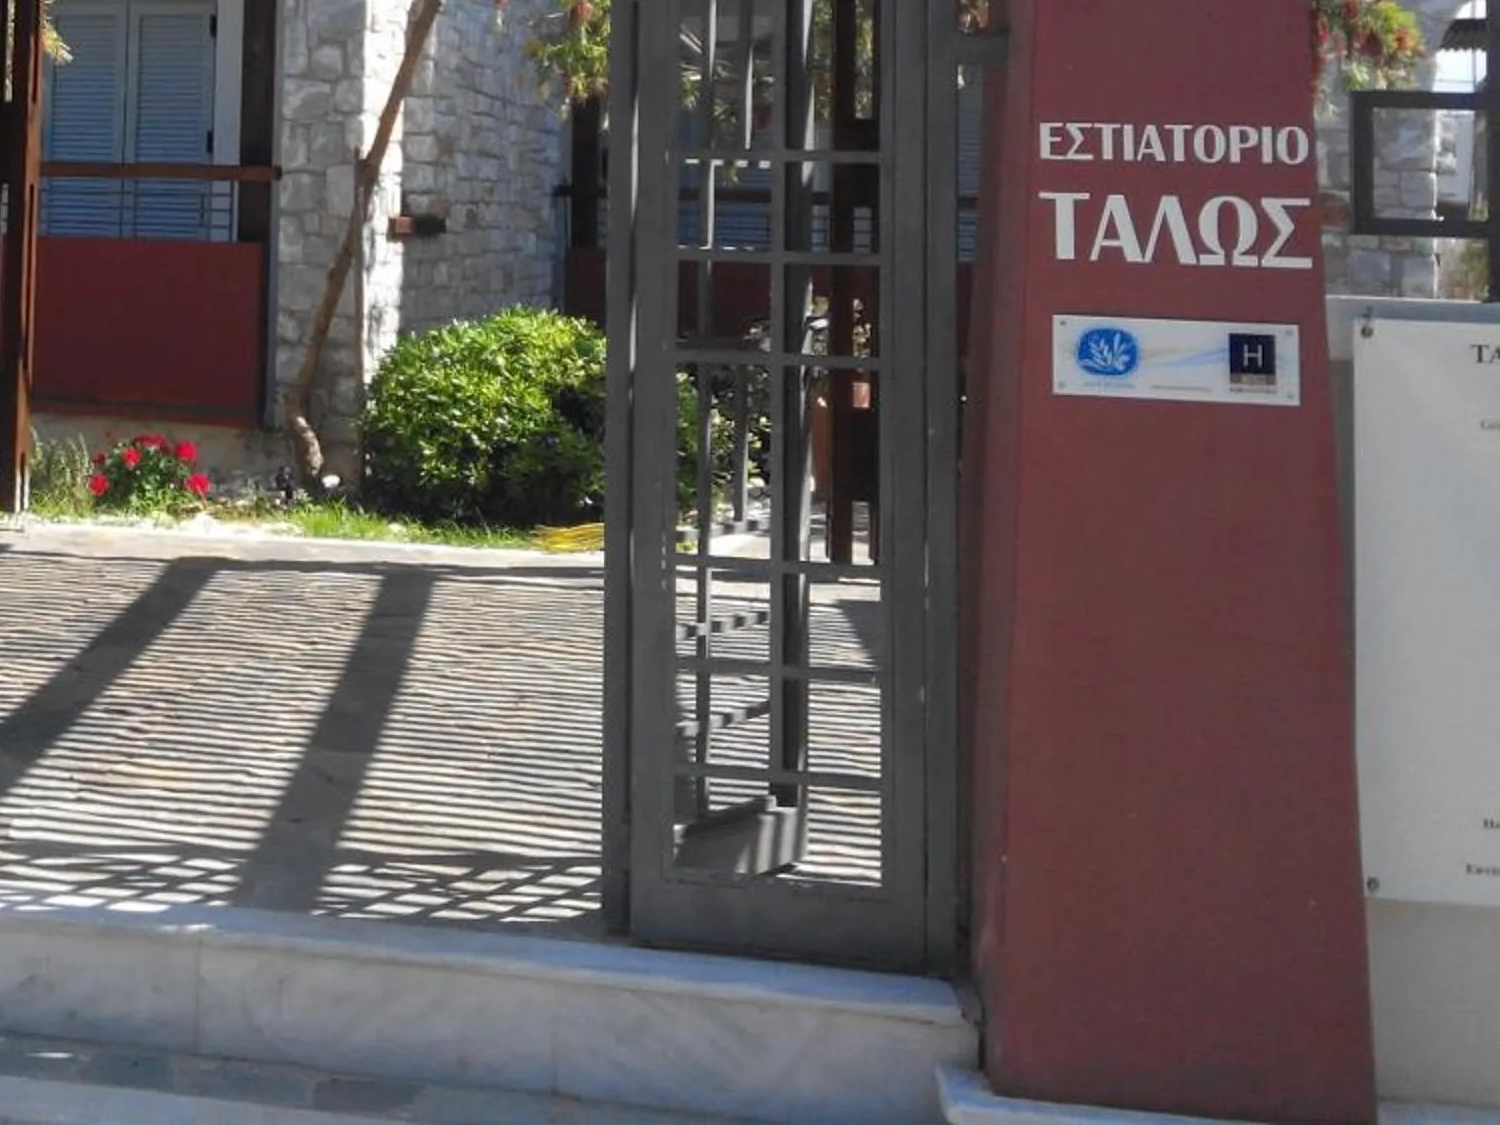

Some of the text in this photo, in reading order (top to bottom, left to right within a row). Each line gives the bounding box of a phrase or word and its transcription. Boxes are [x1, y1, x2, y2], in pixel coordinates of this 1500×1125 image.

[1039, 122, 1310, 165] ΕΣΤΙΑΤΟΡΙΟ
[1038, 191, 1313, 269] ΤΑΛΩΣ
[1243, 344, 1263, 367] H
